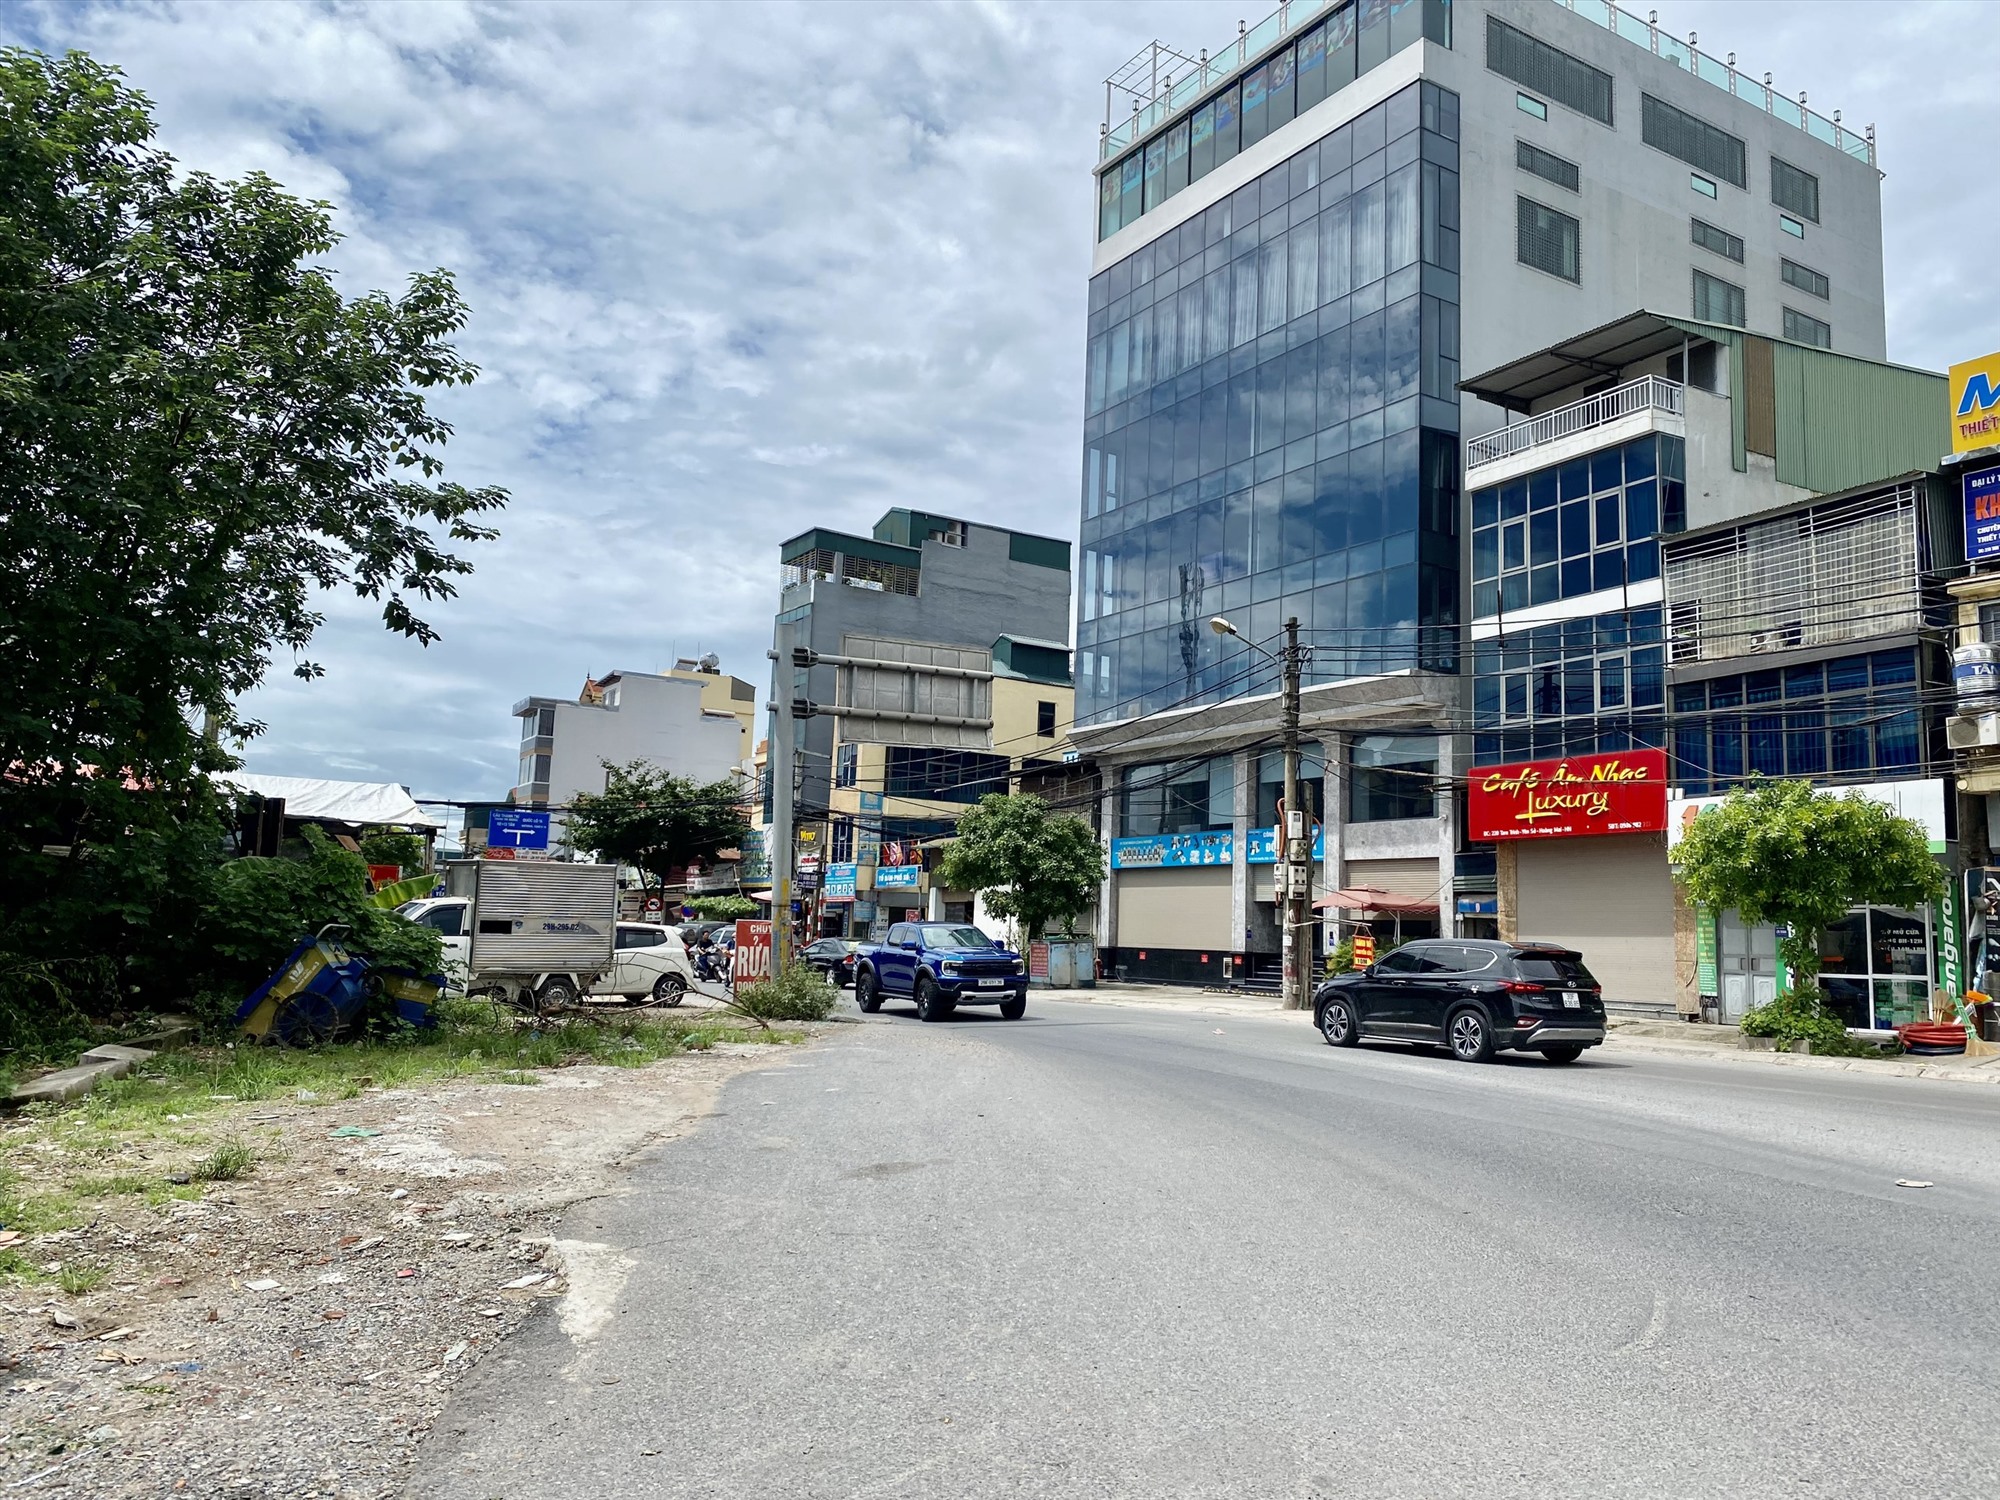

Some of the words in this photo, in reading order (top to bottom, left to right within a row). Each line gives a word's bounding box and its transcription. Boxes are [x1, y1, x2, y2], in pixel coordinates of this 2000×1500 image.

[1959, 414, 1998, 436] THIẾT
[1482, 767, 1541, 799] Café
[1515, 791, 1610, 825] Luxury
[737, 935, 771, 977] RỬA
